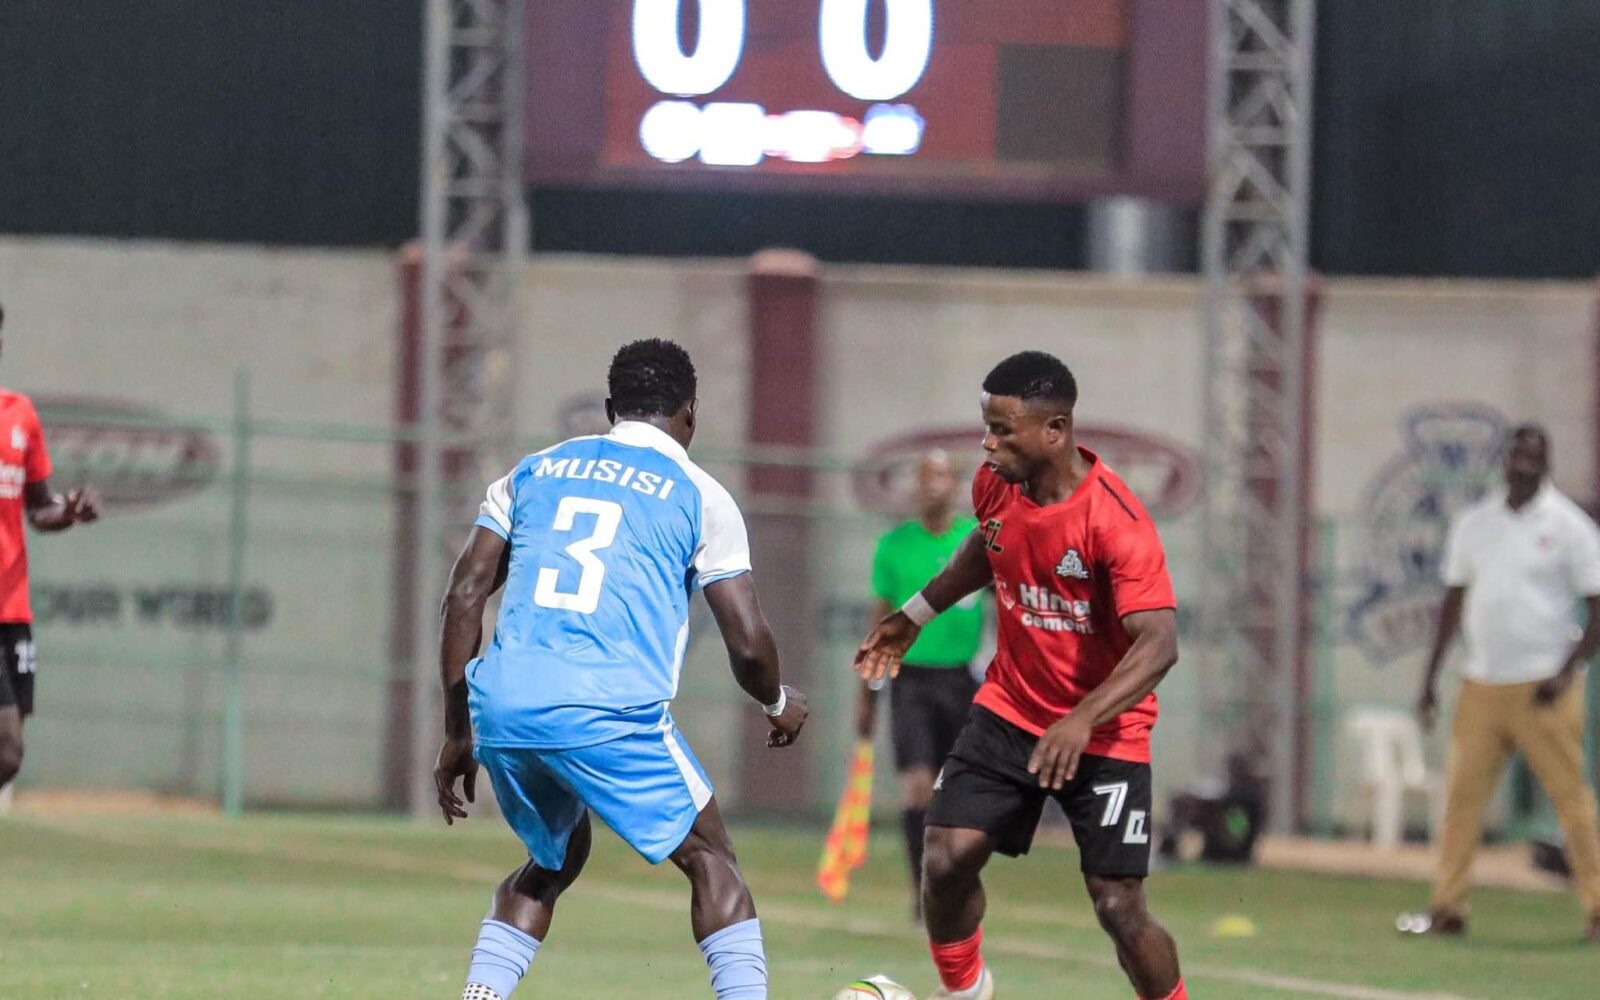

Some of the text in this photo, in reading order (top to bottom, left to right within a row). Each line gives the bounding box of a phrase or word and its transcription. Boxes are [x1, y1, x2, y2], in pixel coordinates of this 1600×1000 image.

[535, 456, 675, 500] MUSISI
[533, 496, 623, 615] 3
[1092, 781, 1129, 827] 7
